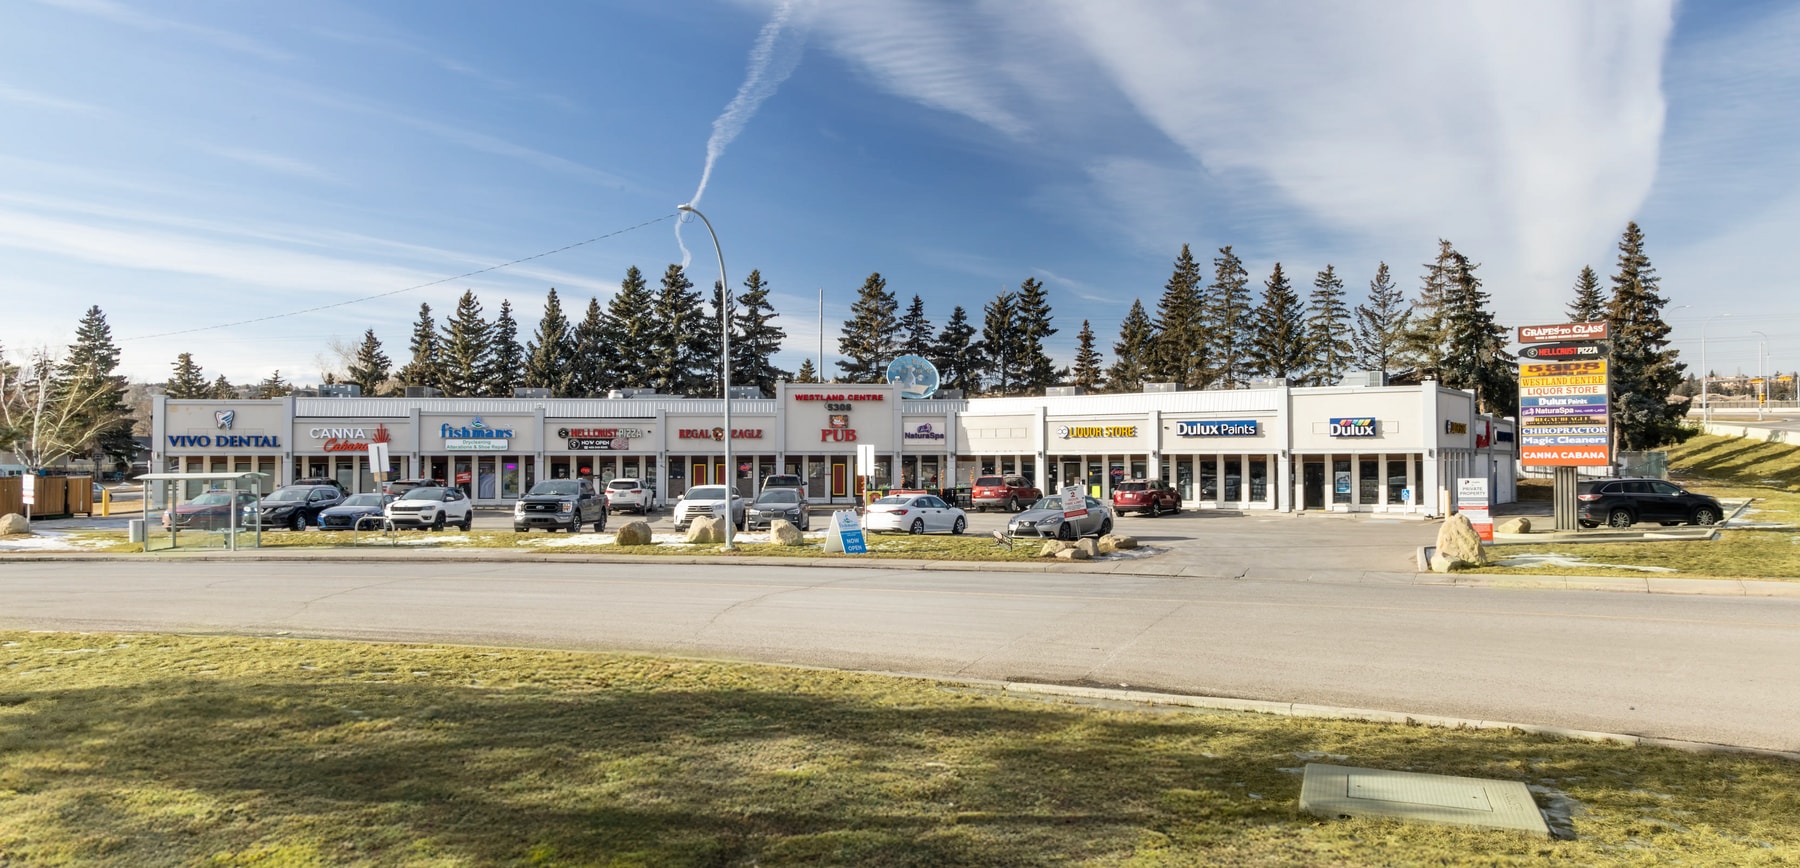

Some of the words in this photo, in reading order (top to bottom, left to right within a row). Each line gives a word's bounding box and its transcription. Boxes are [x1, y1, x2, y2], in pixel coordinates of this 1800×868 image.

[1522, 326, 1558, 336] GRAPES
[1572, 323, 1605, 334] GLASS
[1538, 347, 1577, 356] HELLCRUST
[1577, 346, 1598, 354] PIZZA
[1522, 377, 1567, 387] WESTLAND
[1570, 376, 1604, 385] CENTRE
[1528, 388, 1563, 396] LIQUOR
[1566, 386, 1598, 394] STORE
[794, 393, 845, 401] WESTLAND
[847, 393, 883, 401] CENTRE
[1538, 397, 1567, 405] Dulux
[827, 403, 852, 411] 5308
[1535, 406, 1574, 415] NaturaSpa
[310, 428, 366, 439] CANNA
[570, 428, 618, 438] HELLCRUST
[618, 428, 643, 438] PIZZA
[679, 429, 711, 438] REGAL
[731, 429, 763, 439] EAGLE
[1070, 427, 1103, 438] LIQUOR
[1104, 426, 1136, 437] STORE
[1177, 423, 1219, 435] Dulux
[1221, 424, 1255, 434] Paints
[1330, 424, 1374, 436] Dulux
[1522, 427, 1607, 435] CHIROPRACTOR
[821, 429, 857, 443] PUB
[904, 432, 944, 440] NaturaSpa
[1522, 437, 1554, 446] Magic
[1557, 436, 1606, 444] Cleaners
[167, 435, 211, 448] VIVO
[215, 435, 280, 448] DENTAL
